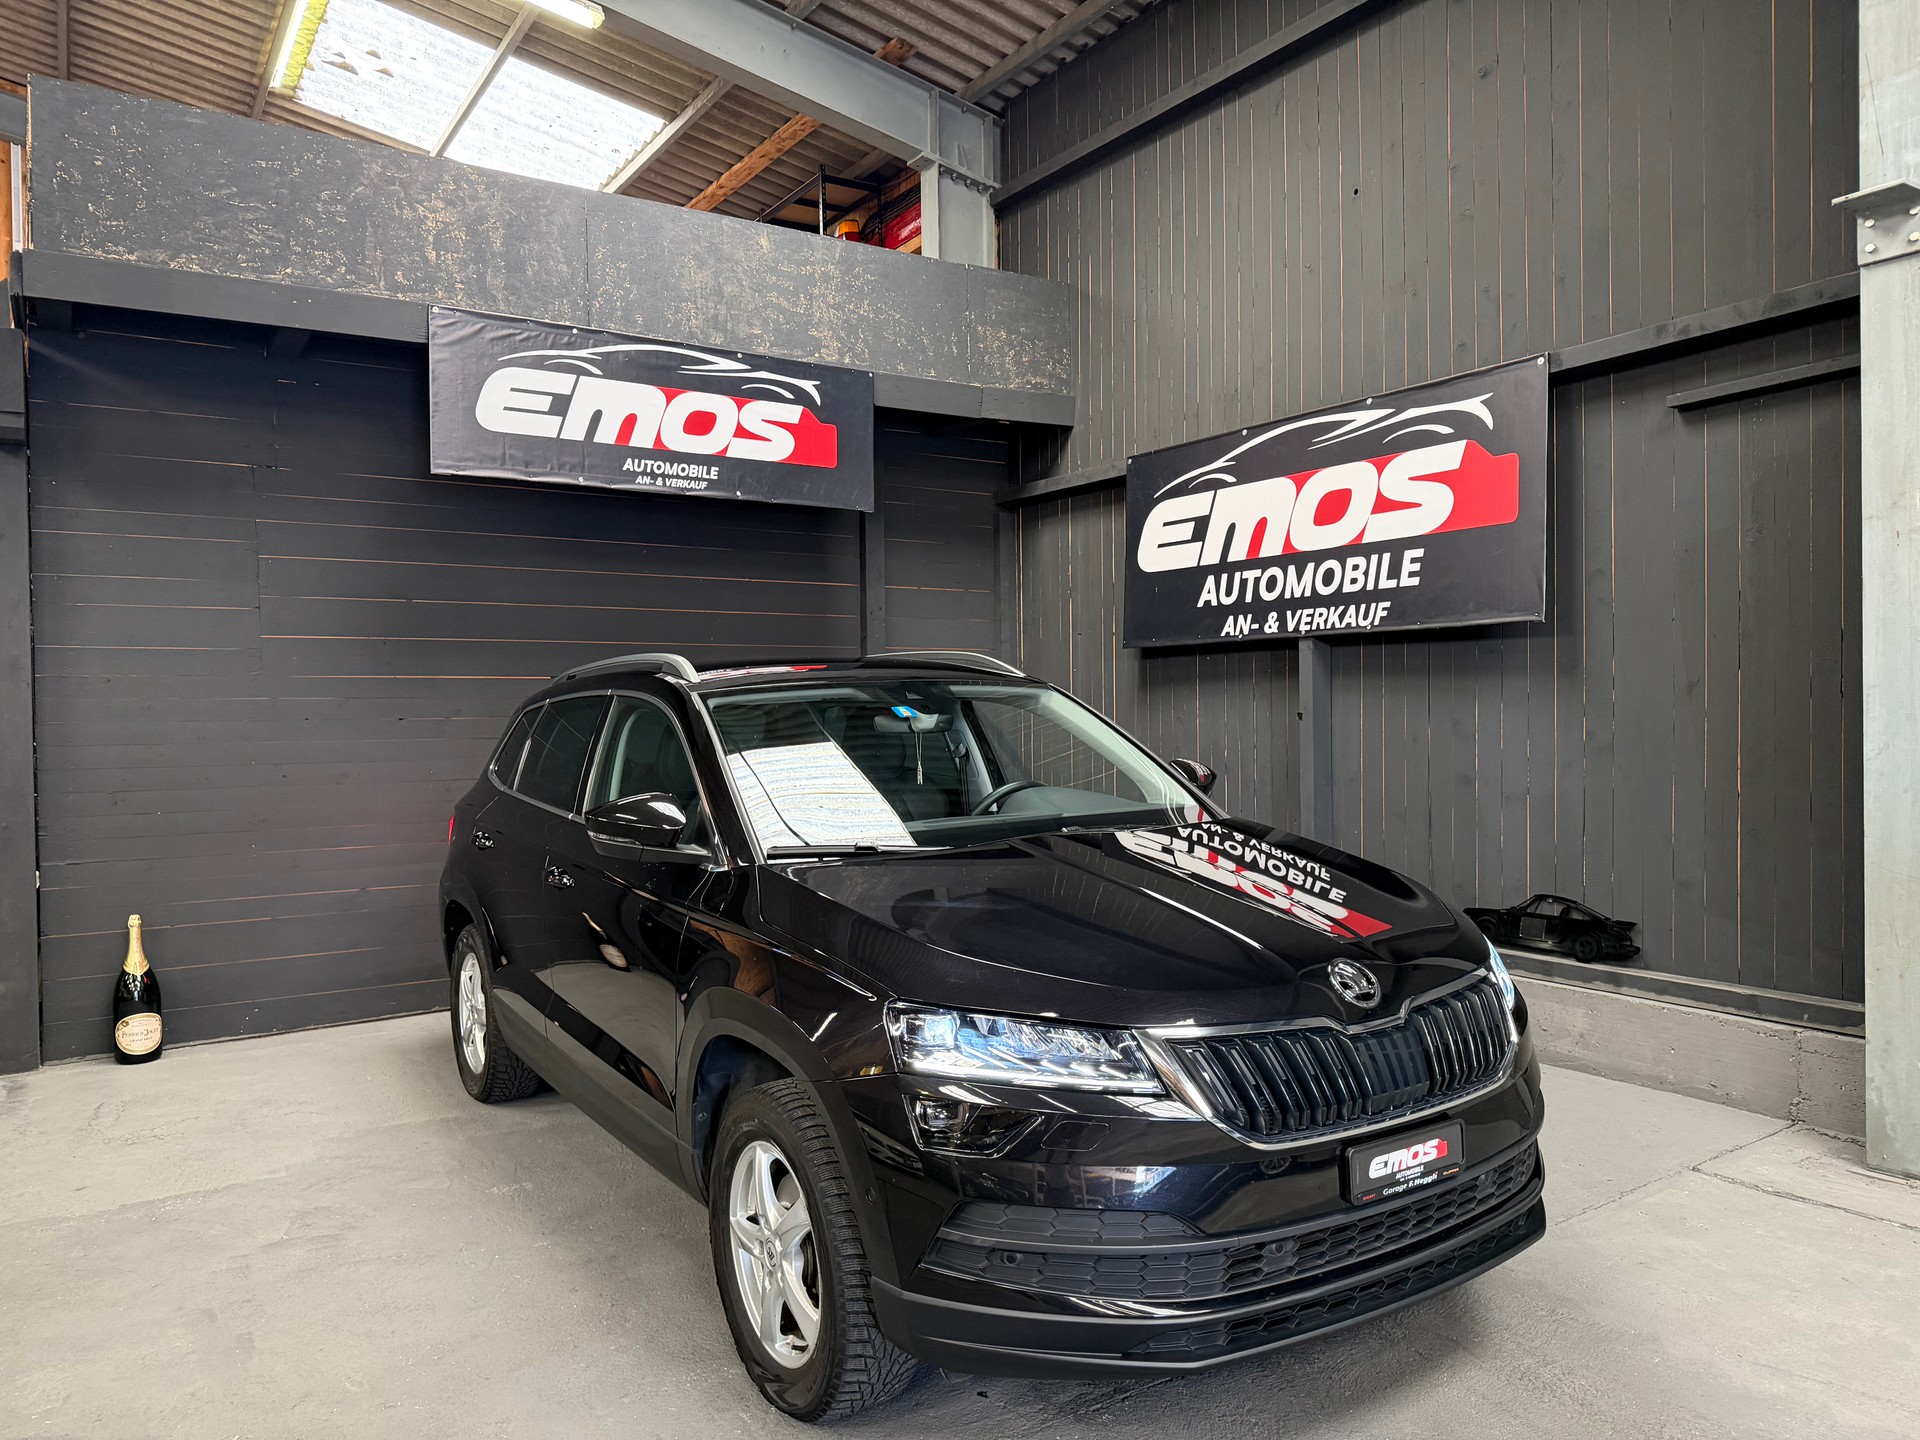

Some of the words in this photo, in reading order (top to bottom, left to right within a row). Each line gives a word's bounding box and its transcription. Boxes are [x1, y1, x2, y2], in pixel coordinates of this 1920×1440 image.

[623, 458, 719, 480] AUTOMOBILE
[635, 475, 655, 485] AN-
[655, 477, 663, 486] &
[665, 478, 708, 490] VERKAUF
[1197, 548, 1424, 608] AUTOMOBILE
[1221, 613, 1259, 636] AN-
[1264, 611, 1279, 634] &
[1286, 601, 1391, 632] VERKAUF
[1382, 1184, 1407, 1196] Garage
